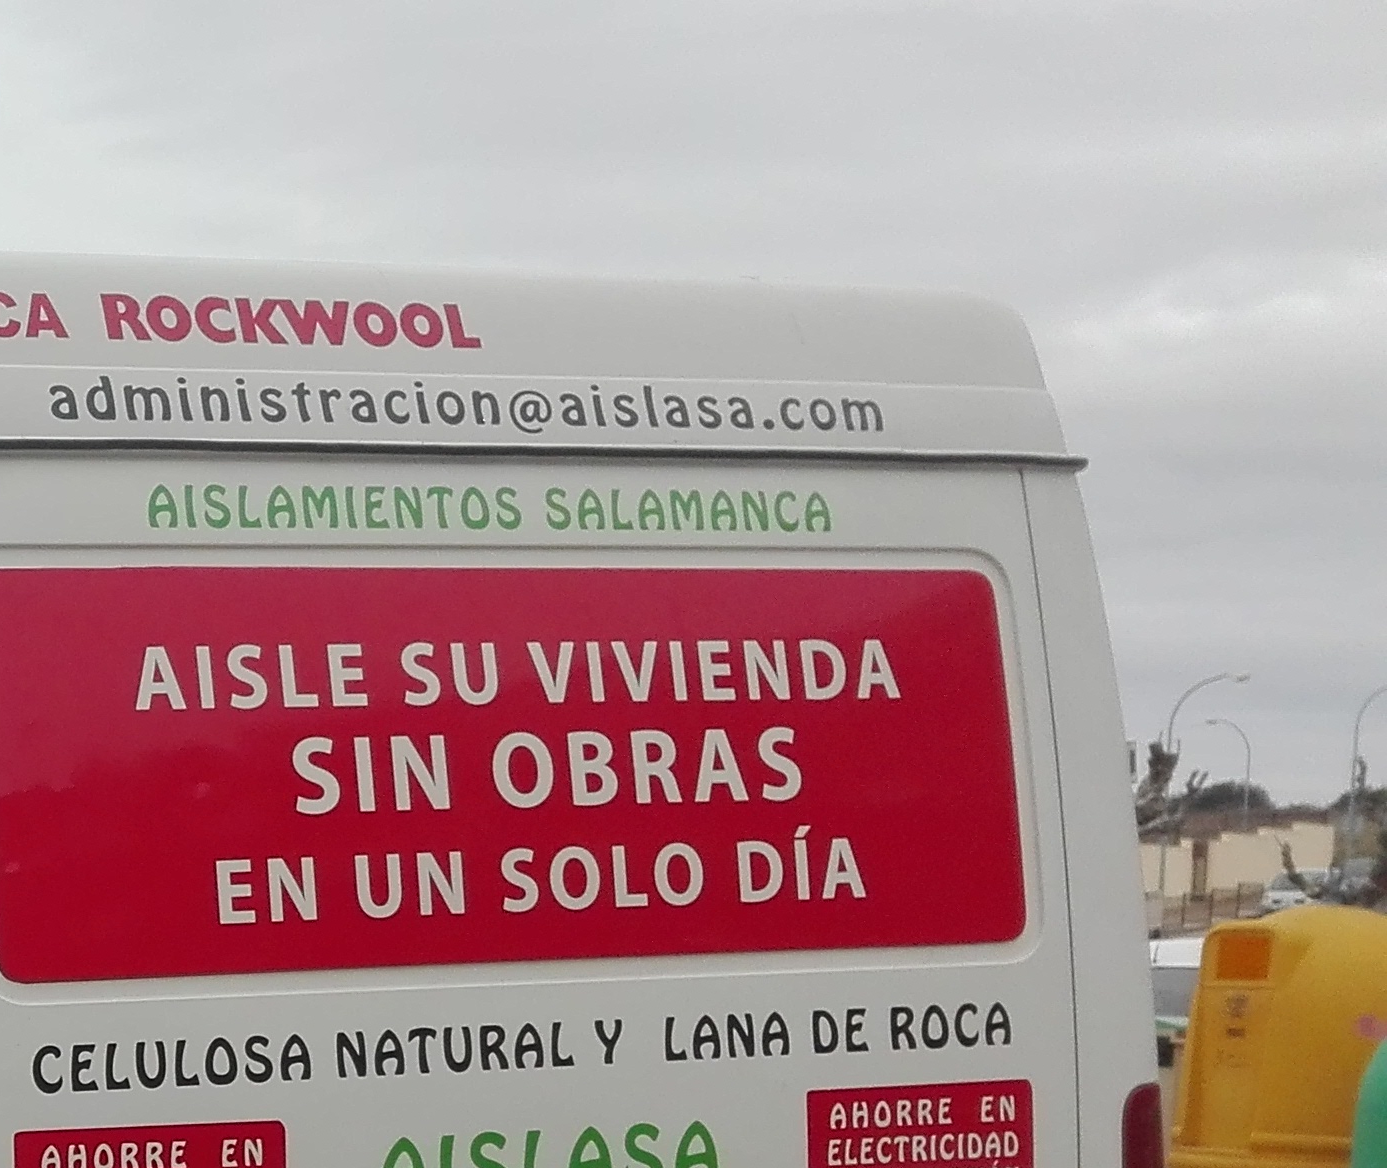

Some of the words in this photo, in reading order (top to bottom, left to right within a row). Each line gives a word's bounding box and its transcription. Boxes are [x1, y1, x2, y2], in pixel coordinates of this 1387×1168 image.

[100, 294, 481, 348] ROCKWOOL
[49, 376, 883, 433] administracion@aislasa.com
[148, 485, 522, 530] AISLAMIENTOS
[546, 488, 831, 532] SALAMANCA
[136, 644, 368, 710] AISLE
[401, 642, 498, 706] SU
[527, 639, 900, 703] VIVIENDA
[292, 735, 450, 815] SIN
[492, 727, 802, 808] OBRAS
[216, 857, 317, 924] EN
[354, 851, 465, 918] UN
[501, 843, 703, 912] SOLO
[737, 825, 866, 903] DÍA
[33, 1034, 311, 1094] CELULOSA
[337, 1022, 574, 1078] NATURAL
[595, 1019, 622, 1064] Y
[665, 1012, 789, 1061] LANA
[812, 1009, 869, 1053] DE
[891, 1003, 1011, 1050] ROCA
[830, 1098, 952, 1129] AHORRE
[981, 1095, 1015, 1122] EN
[222, 1139, 262, 1167] EN
[828, 1131, 1019, 1166] ELECTRICIDAD
